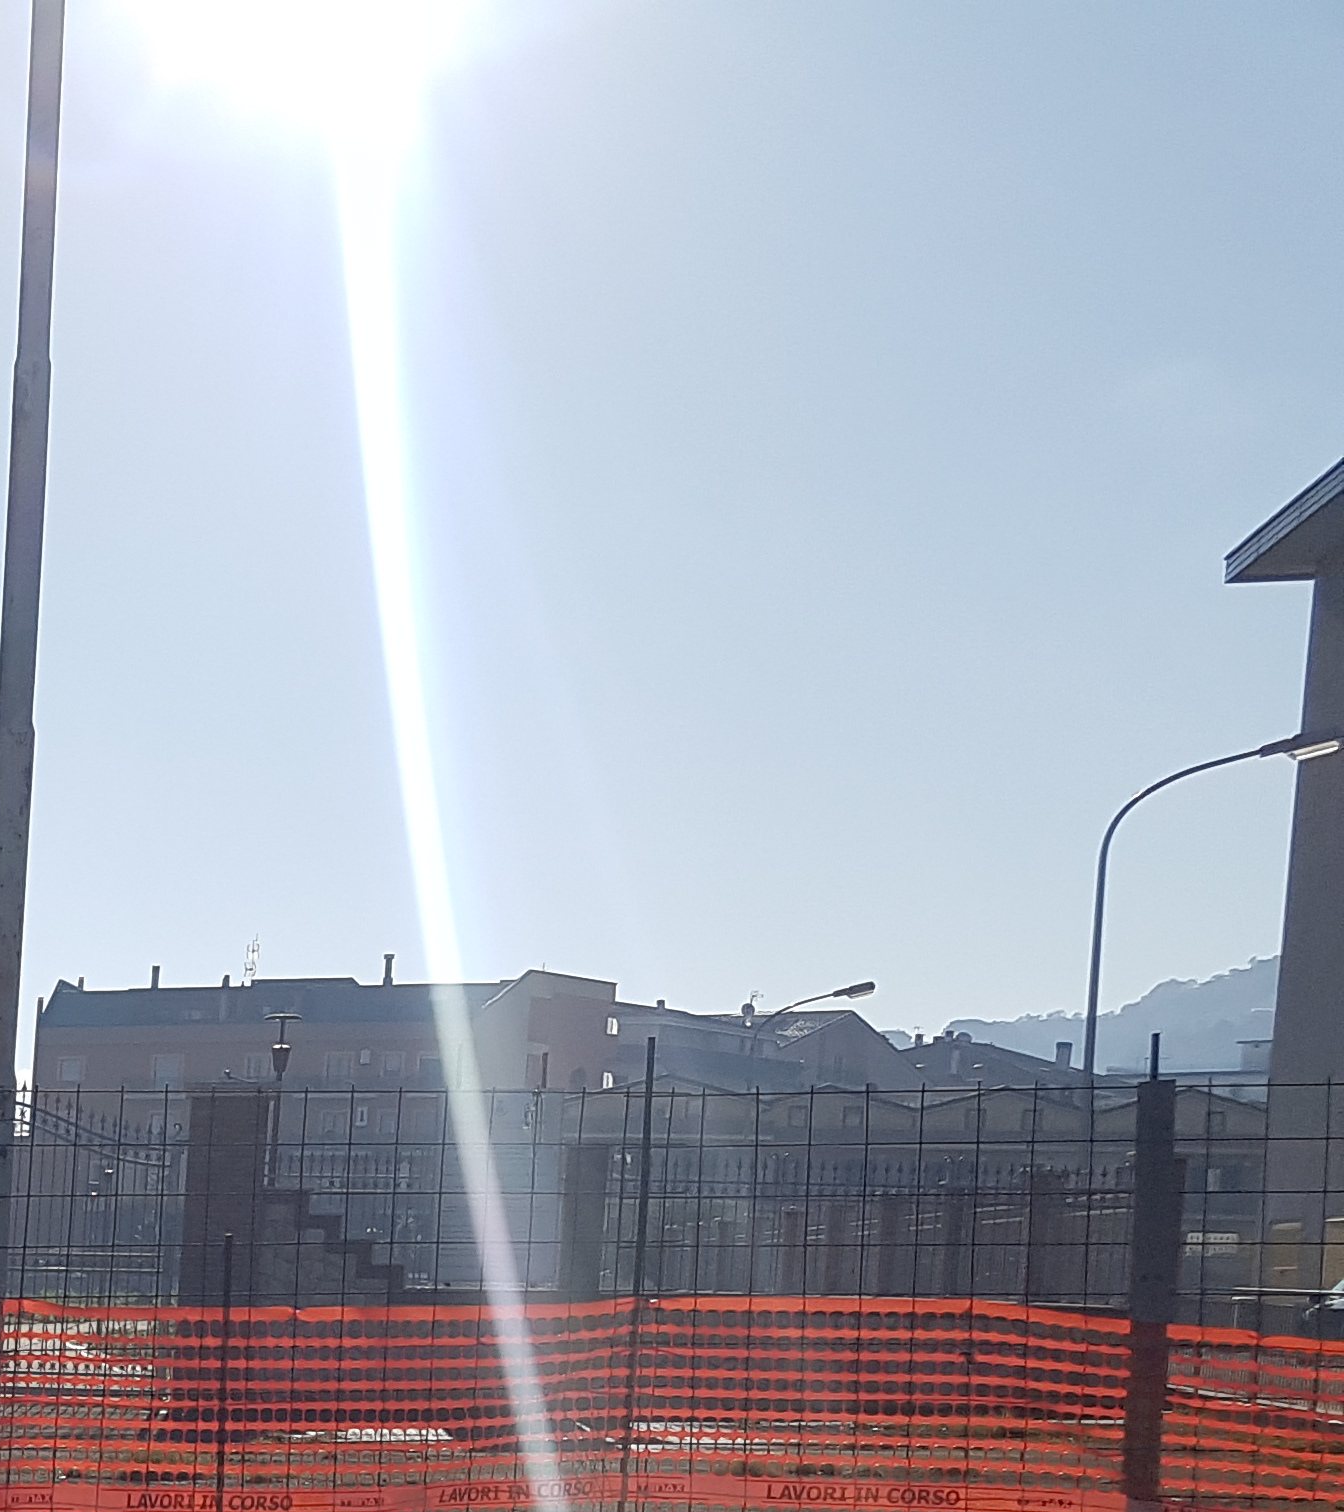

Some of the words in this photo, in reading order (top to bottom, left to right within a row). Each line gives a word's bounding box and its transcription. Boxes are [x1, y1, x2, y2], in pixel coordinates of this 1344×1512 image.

[126, 1493, 194, 1509] LAVORI
[228, 1494, 293, 1511] CORSO
[438, 1484, 500, 1504] LAVORI
[507, 1484, 529, 1499] IN
[536, 1481, 593, 1498] CORSO
[766, 1483, 847, 1502] LAVORI
[854, 1486, 880, 1502] IN
[886, 1487, 961, 1506] CORSO
